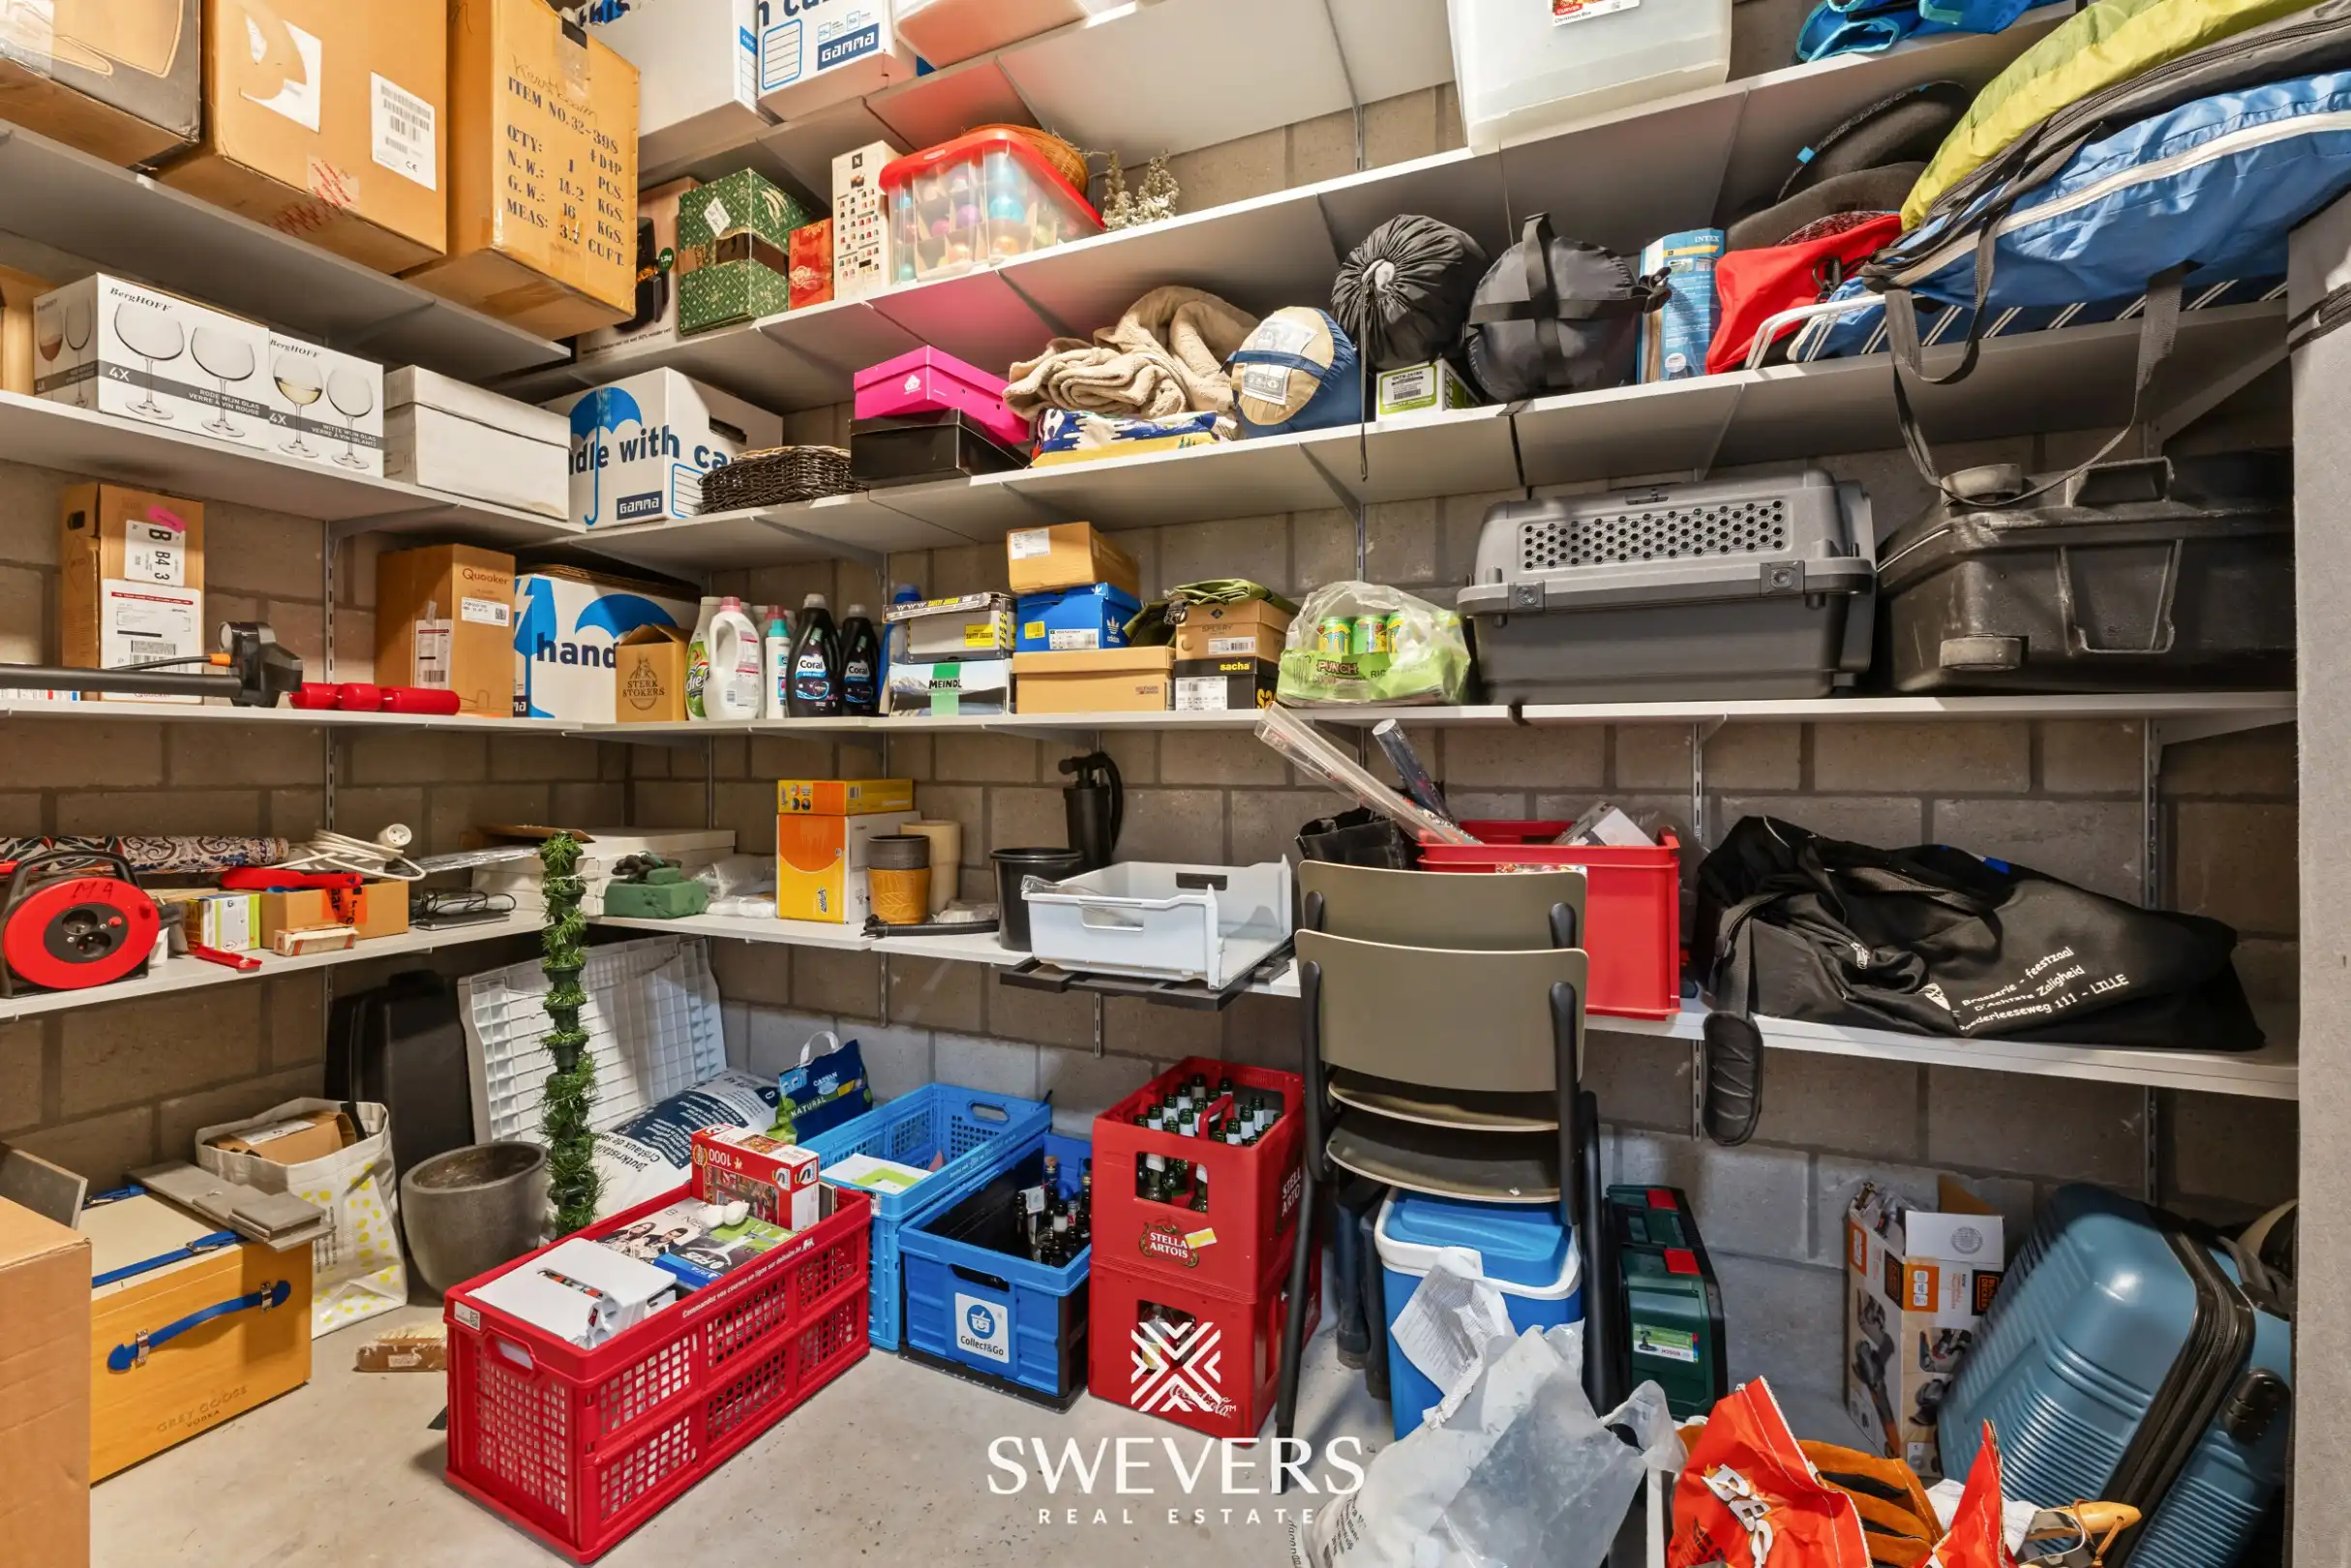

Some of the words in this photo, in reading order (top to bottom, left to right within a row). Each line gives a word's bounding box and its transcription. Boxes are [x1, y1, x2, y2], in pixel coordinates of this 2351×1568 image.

[508, 76, 541, 108] ITEM
[598, 176, 624, 202] PCS.
[507, 197, 549, 228] MEAS:
[597, 197, 625, 224] KGS.
[562, 202, 576, 220] 16
[597, 220, 624, 246] KGS.
[109, 286, 173, 313] BergHOFF
[269, 339, 320, 358] BergHOFF
[109, 366, 130, 382] 4X
[188, 392, 214, 405] VERRE
[222, 400, 234, 409] VIN
[235, 405, 260, 416] ROUGE
[199, 389, 220, 399] RODE
[241, 399, 260, 410] GLAS
[269, 412, 287, 426] 4X
[619, 424, 680, 463] with
[462, 568, 509, 585] Quooker
[799, 659, 824, 670] Coral
[848, 665, 868, 675] Coral
[1220, 662, 1251, 671] sacha
[1316, 659, 1359, 676] PUNCH
[622, 687, 665, 697] STOKERS
[627, 679, 658, 688] STERK
[928, 678, 962, 690] MEINDL
[1961, 982, 2017, 1007] Brasserie
[2025, 946, 2074, 980] feestzaal
[2035, 964, 2086, 997] Zaligheid
[2055, 992, 2078, 1010] 111
[2090, 974, 2129, 995] LILLE
[790, 1096, 827, 1118] NATURAL
[708, 1148, 732, 1167] 1000
[1150, 1231, 1189, 1250] STELLA
[1150, 1242, 1189, 1259] ARTOIS
[960, 1335, 1005, 1356] Collect&Go
[157, 1409, 195, 1432] GREY
[199, 1385, 248, 1413] GOOSE
[186, 1409, 220, 1428] VODKA
